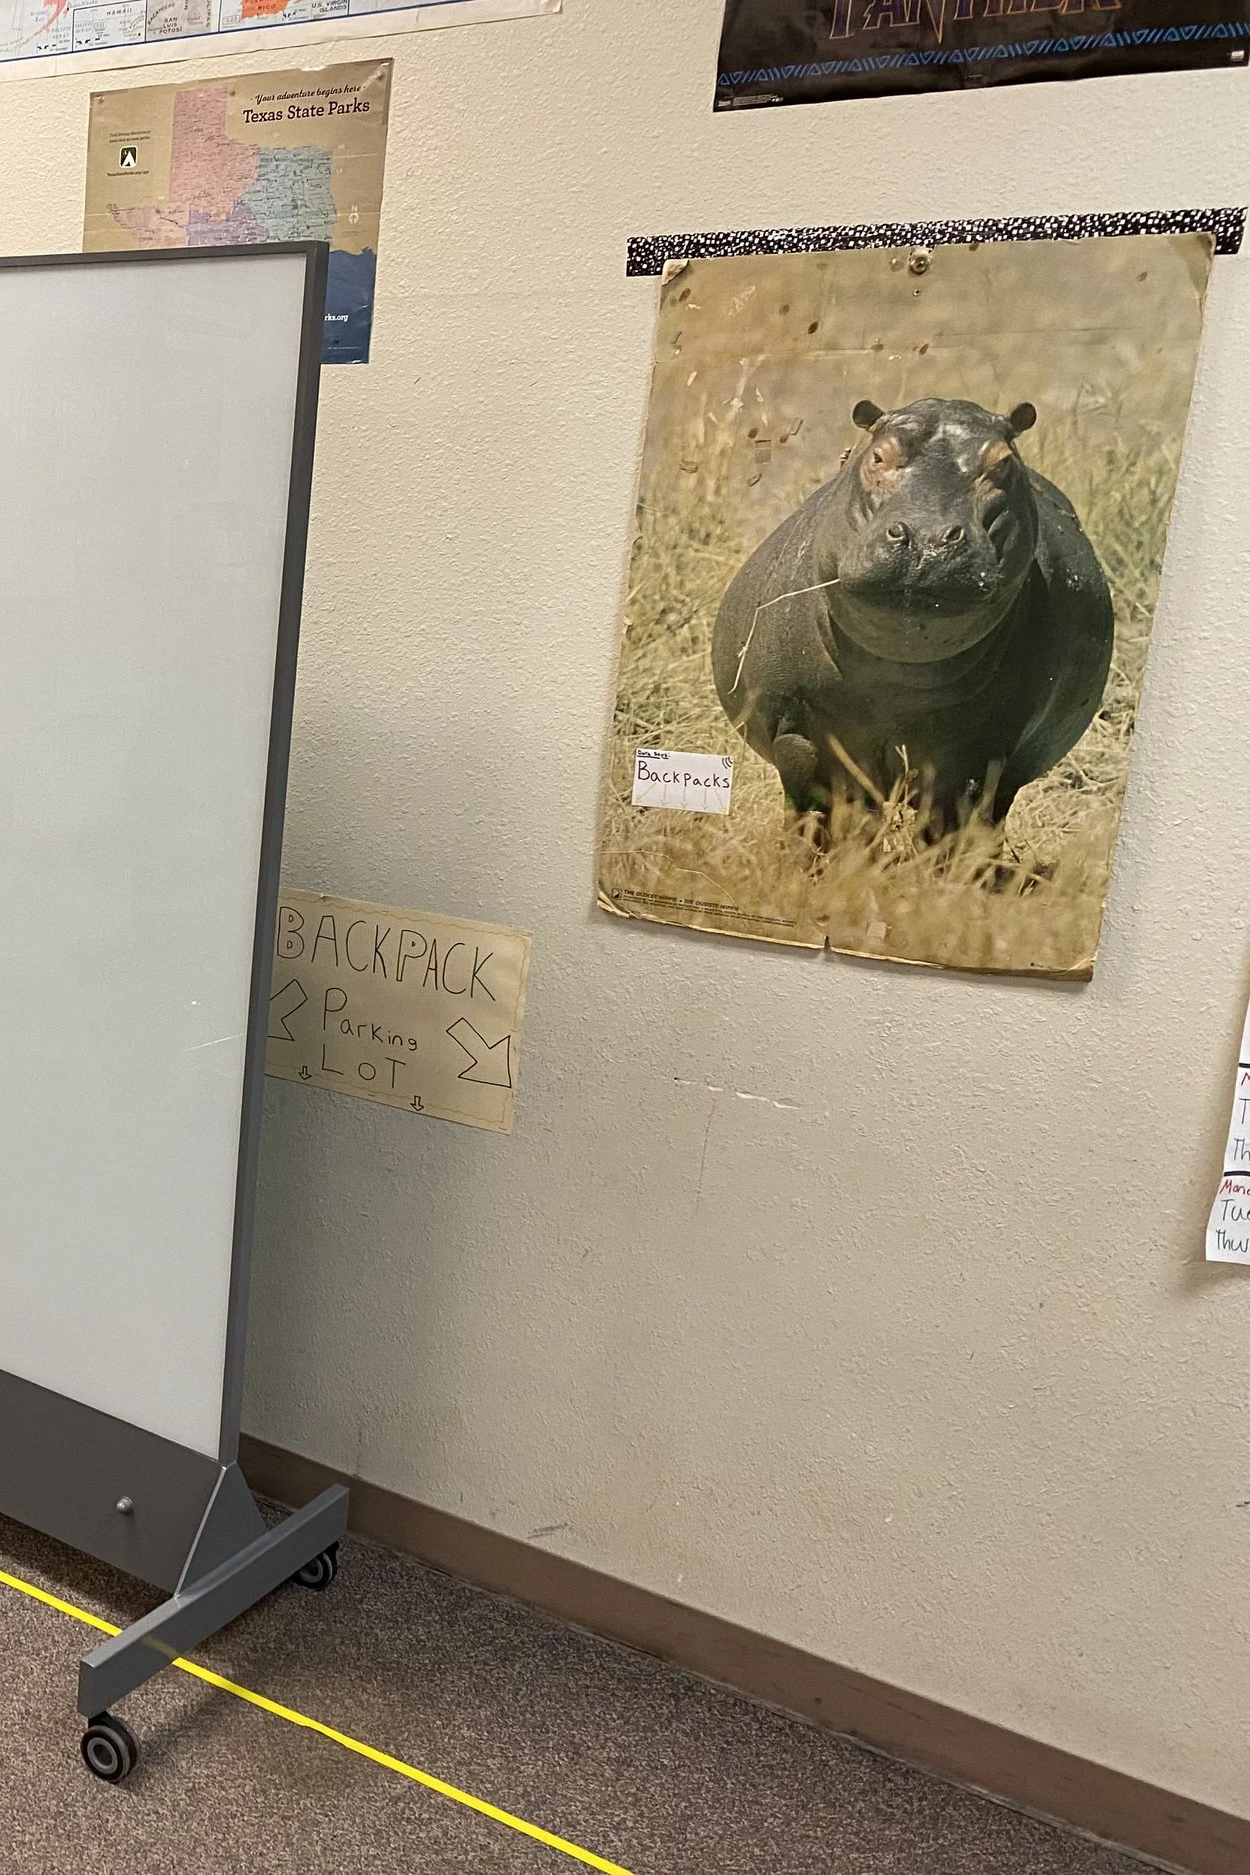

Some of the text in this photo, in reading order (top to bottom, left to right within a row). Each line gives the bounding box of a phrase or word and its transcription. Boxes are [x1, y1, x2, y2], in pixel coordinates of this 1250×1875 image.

[107, 8, 132, 16] HAWAII
[319, 5, 347, 13] ISLANDS
[255, 84, 361, 105] Your adventure begins here
[243, 97, 370, 124] Texas State Parks
[324, 313, 349, 323] rks.org
[276, 905, 496, 1002] BACKPACK
[323, 987, 418, 1052] Parking
[322, 1043, 407, 1089] LOT
